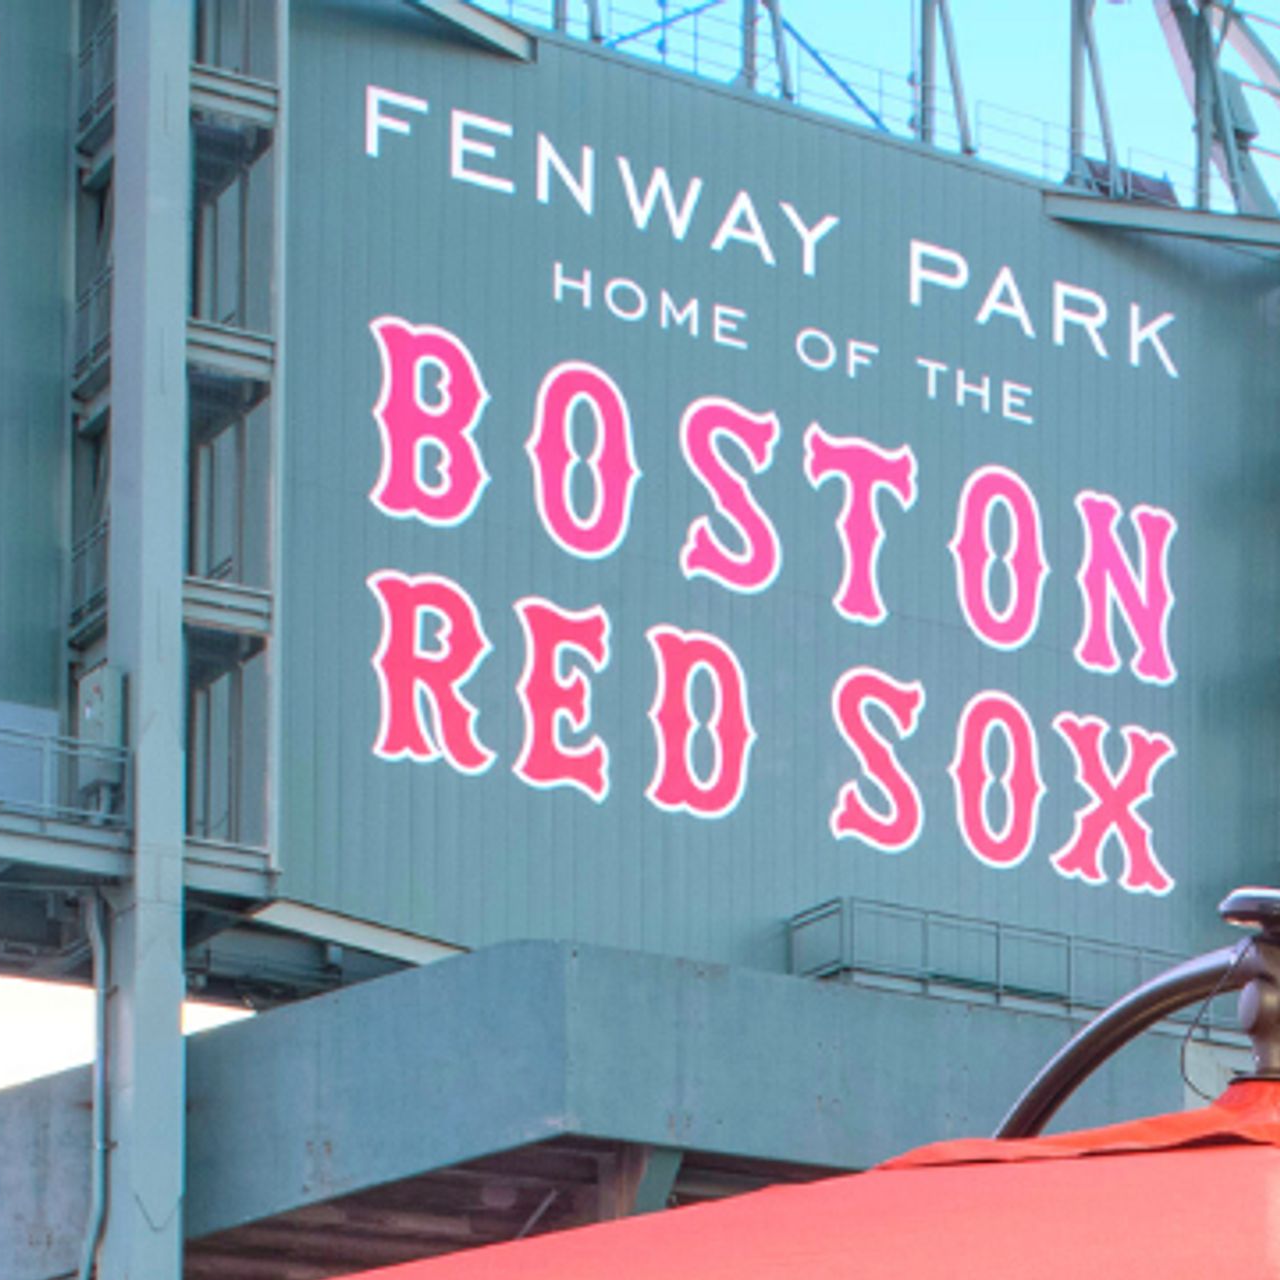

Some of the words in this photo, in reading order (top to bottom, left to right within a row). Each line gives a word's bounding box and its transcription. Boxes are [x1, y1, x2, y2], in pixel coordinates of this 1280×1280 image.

[365, 85, 839, 276] FENWAY
[909, 238, 1179, 378] PARK
[553, 261, 749, 350] HOME
[795, 327, 879, 380] OF
[916, 356, 1035, 425] THE
[369, 315, 1178, 686] BOSTON
[366, 567, 757, 819] RED
[829, 665, 1177, 896] SOX
